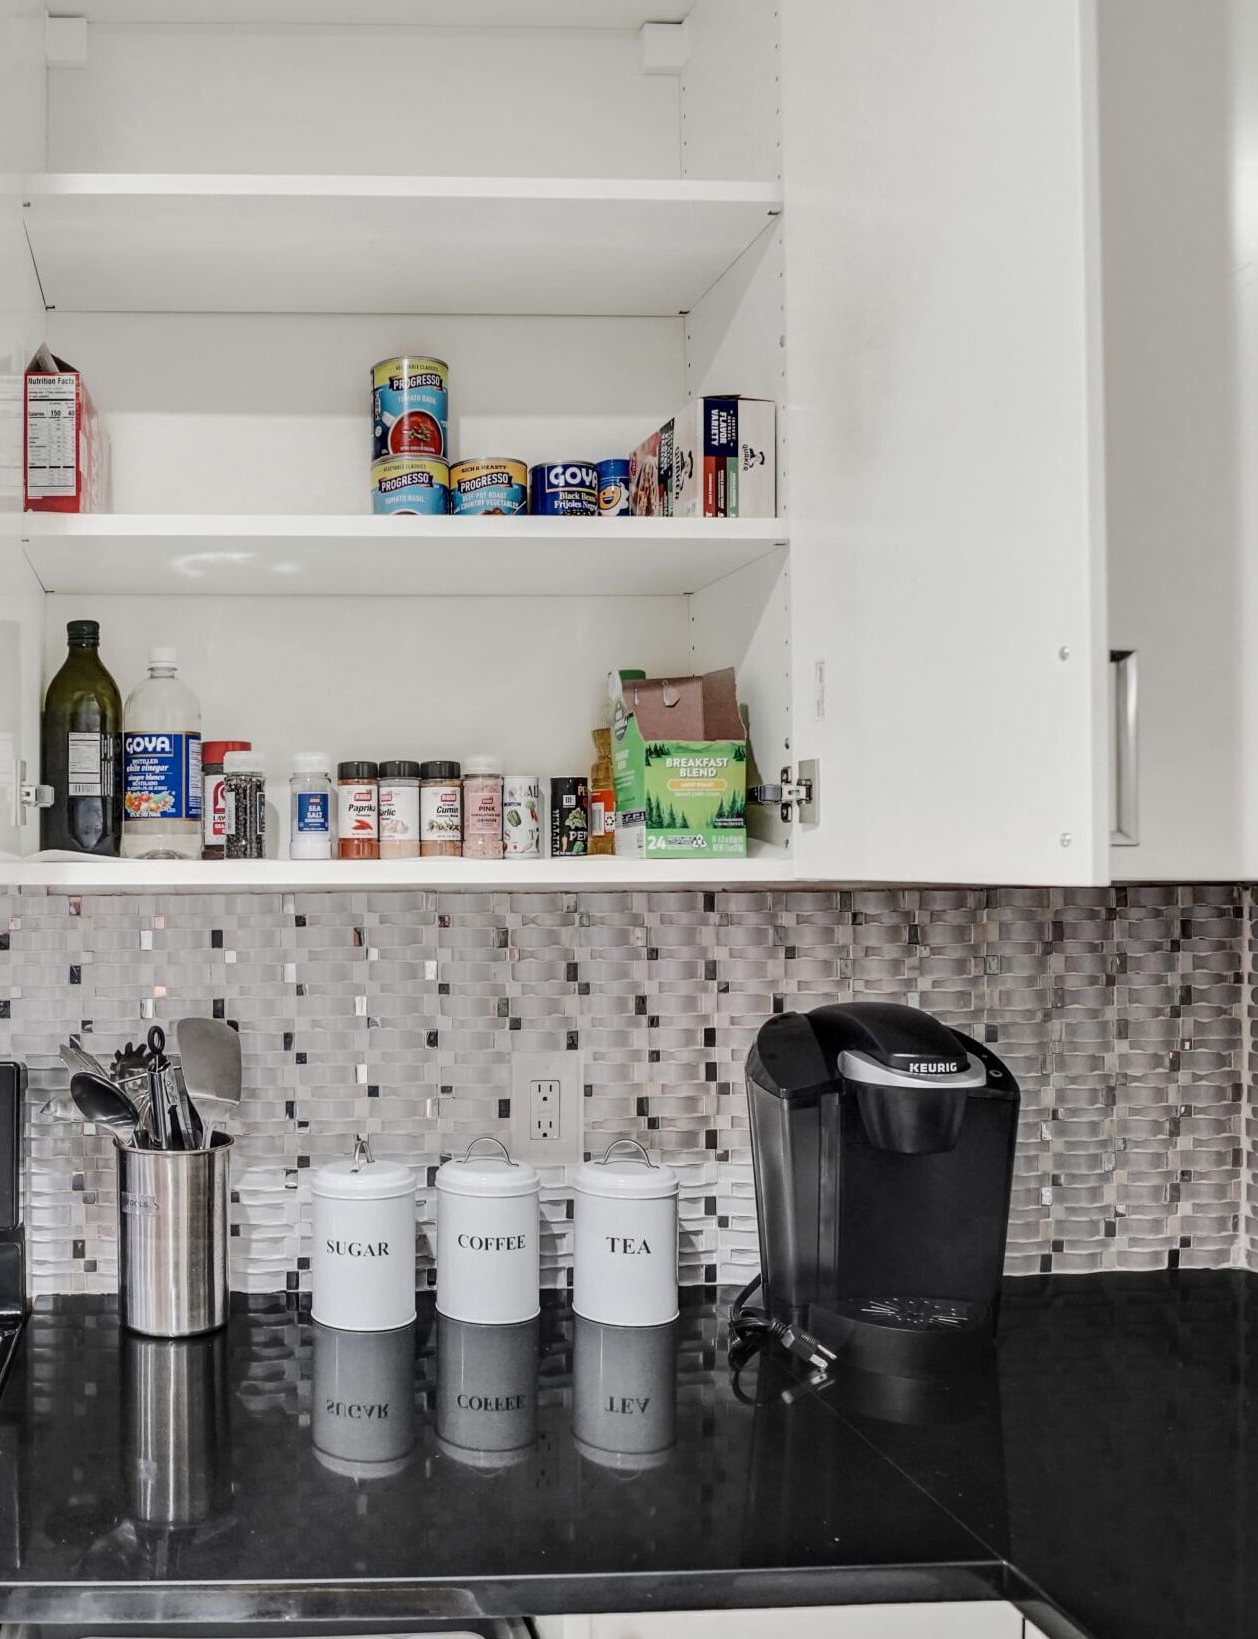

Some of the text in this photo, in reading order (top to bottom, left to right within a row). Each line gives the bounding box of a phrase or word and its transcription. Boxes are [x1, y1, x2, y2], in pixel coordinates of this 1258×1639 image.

[28, 377, 56, 385] Nutrition
[393, 374, 441, 390] PROGRESSO
[711, 409, 719, 446] VARIETY
[719, 411, 727, 444] FLAVOR
[381, 472, 430, 492] PROGRESSO
[460, 473, 509, 493] PROGRESSO
[549, 465, 598, 488] GOYA
[559, 491, 580, 500] Black
[554, 500, 582, 510] Frijoles
[126, 736, 170, 754] GOYA
[141, 765, 170, 773] vinegar
[665, 757, 729, 768] BREAKFAST
[679, 767, 717, 777] BLEND
[348, 804, 376, 813] Paprika
[436, 805, 459, 814] Cumin
[647, 835, 667, 850] 24
[908, 1061, 958, 1075] KEURIG
[326, 1239, 390, 1258] SUGAR
[457, 1233, 527, 1251] COFFEE
[605, 1236, 652, 1255] TEA
